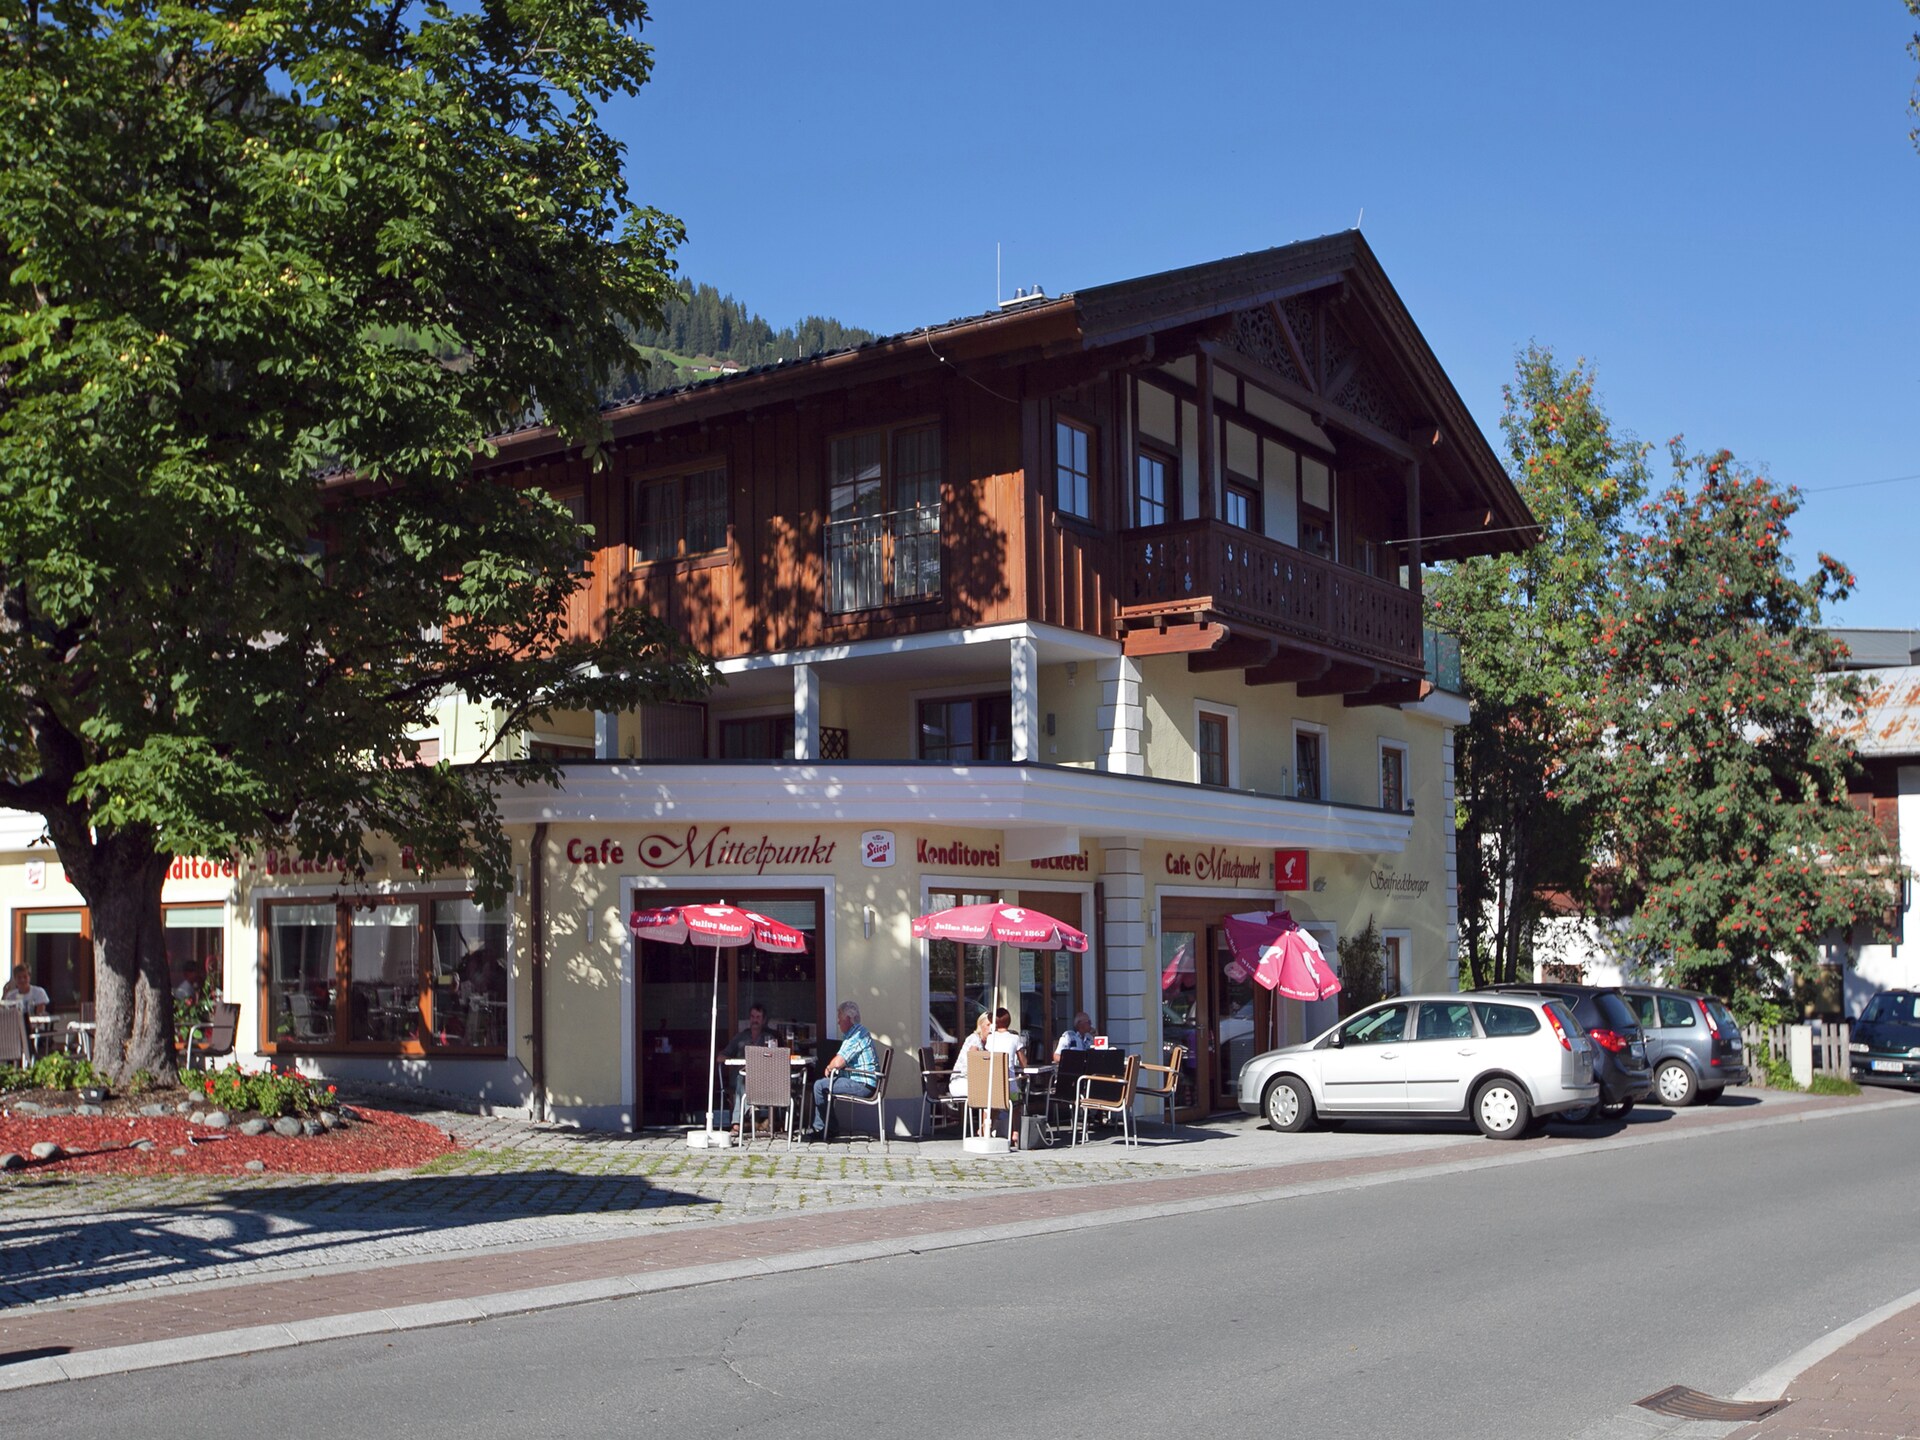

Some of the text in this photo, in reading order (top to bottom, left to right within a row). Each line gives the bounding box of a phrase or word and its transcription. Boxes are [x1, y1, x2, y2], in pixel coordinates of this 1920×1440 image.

[567, 825, 837, 875] Cafe Mittelpunkt
[866, 841, 890, 858] Stiegl
[916, 837, 1000, 867] Konditorei
[1165, 847, 1261, 888] Cafe Mittelpunkt
[690, 919, 743, 932] Julius Meinl
[934, 922, 961, 931] Julius
[961, 924, 985, 932] Meinl
[997, 928, 1046, 938] Wien 1862
